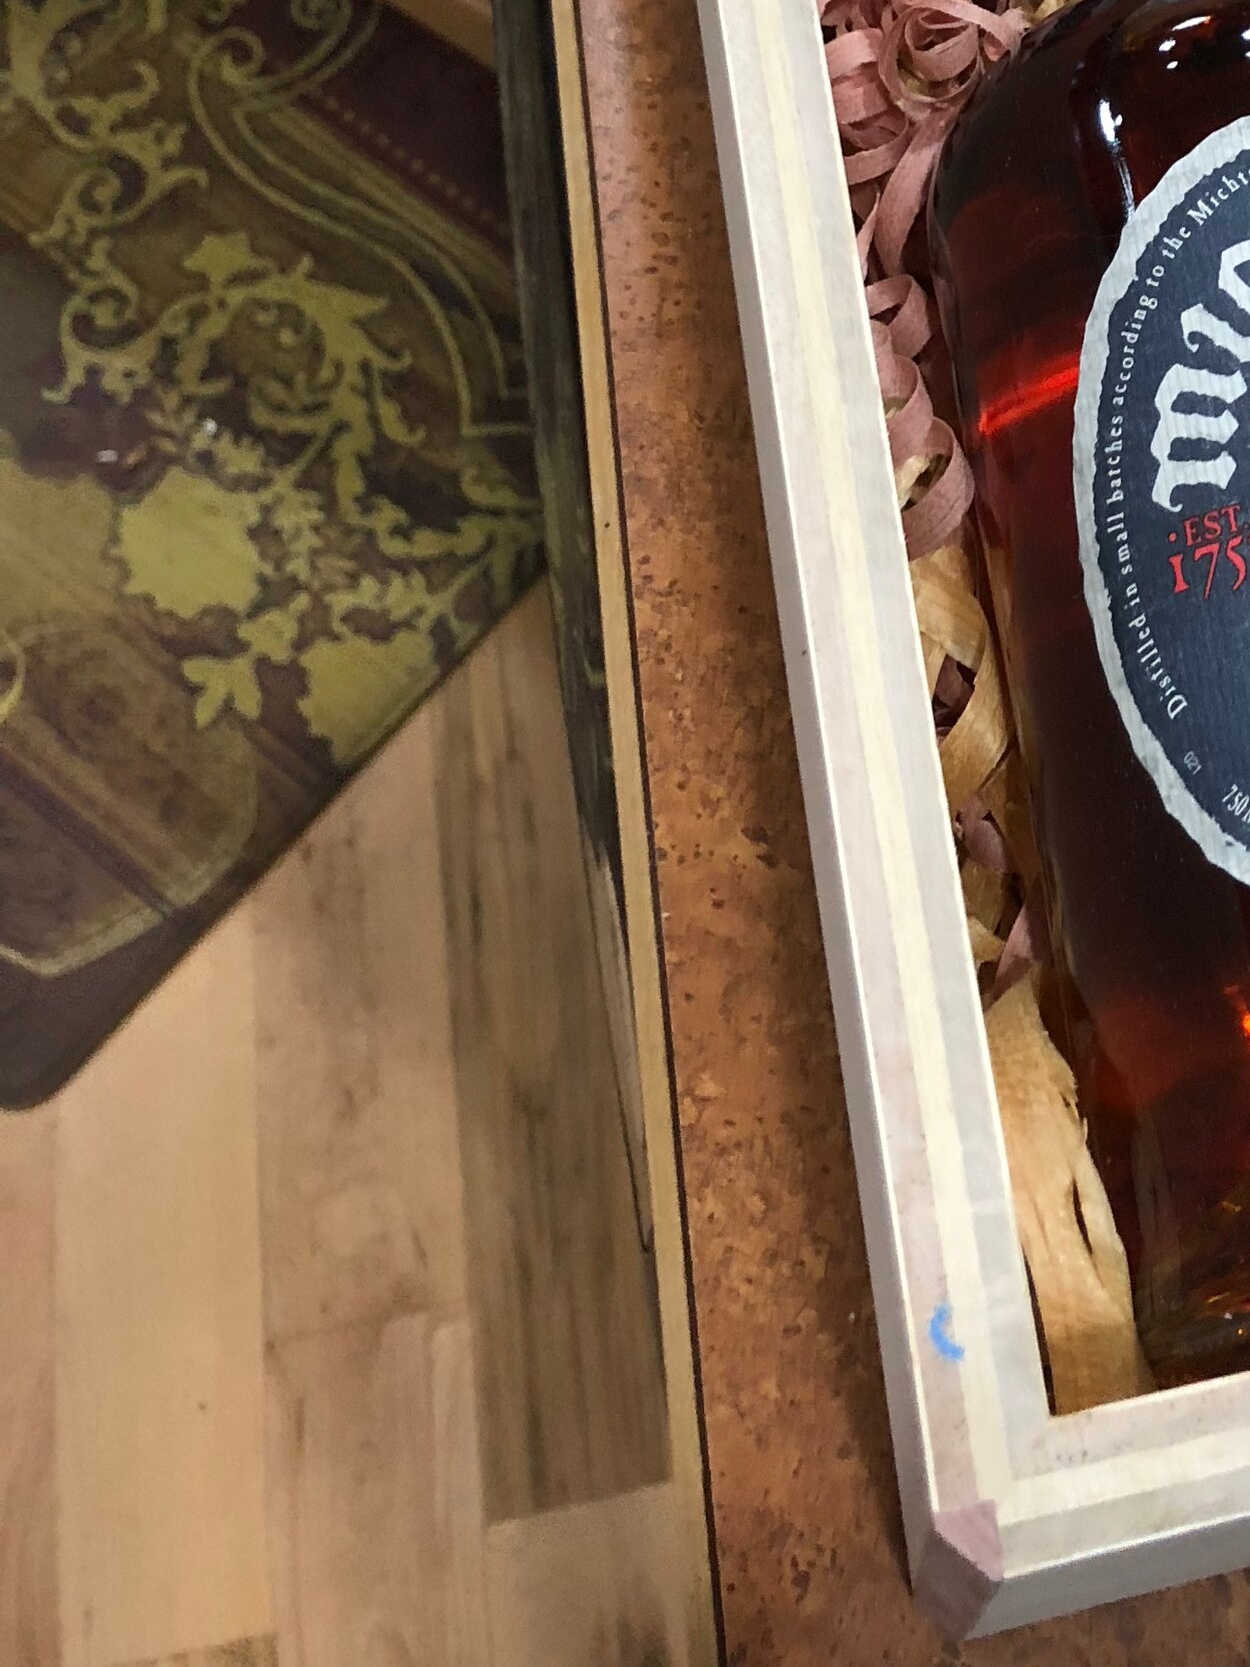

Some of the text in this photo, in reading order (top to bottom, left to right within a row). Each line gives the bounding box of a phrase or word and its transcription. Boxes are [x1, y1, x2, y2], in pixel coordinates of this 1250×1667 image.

[1162, 226, 1191, 260] the
[1146, 265, 1165, 287] to
[1111, 294, 1158, 408] according
[1105, 415, 1125, 507] batches
[1107, 512, 1134, 576] small
[1122, 582, 1143, 608] in
[1128, 610, 1188, 720] Distilled
[1183, 750, 1202, 776] 021
